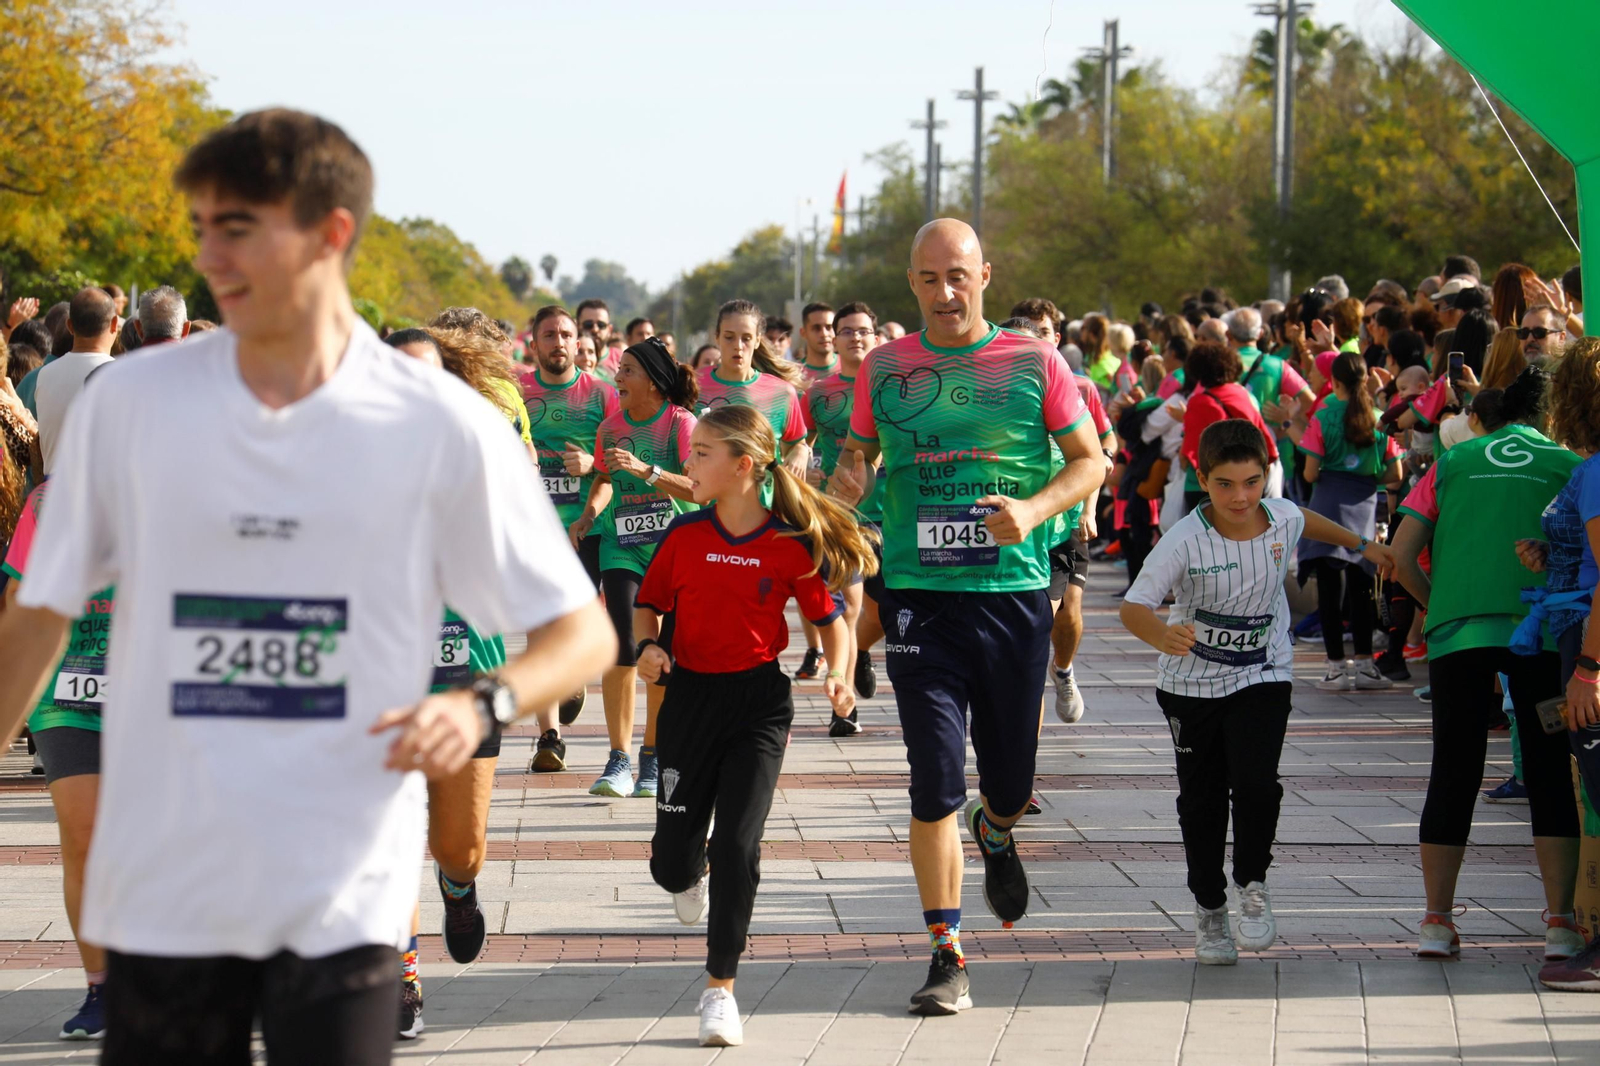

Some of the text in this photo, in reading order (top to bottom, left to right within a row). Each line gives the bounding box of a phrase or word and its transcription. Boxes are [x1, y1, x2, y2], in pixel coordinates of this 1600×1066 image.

[914, 430, 940, 448] La
[914, 446, 999, 464] marcha
[919, 464, 957, 484] que
[619, 481, 635, 492] La
[919, 478, 1020, 501] engancha
[625, 514, 665, 532] 0237
[928, 524, 988, 545] 1045
[706, 553, 760, 568] GIVOVA
[932, 555, 960, 563] engancha
[1188, 562, 1238, 575] GIVOVA
[78, 619, 112, 638] que
[80, 637, 109, 656] eng
[1204, 628, 1260, 649] 1044
[196, 634, 319, 678] 2488
[67, 676, 108, 698] 10
